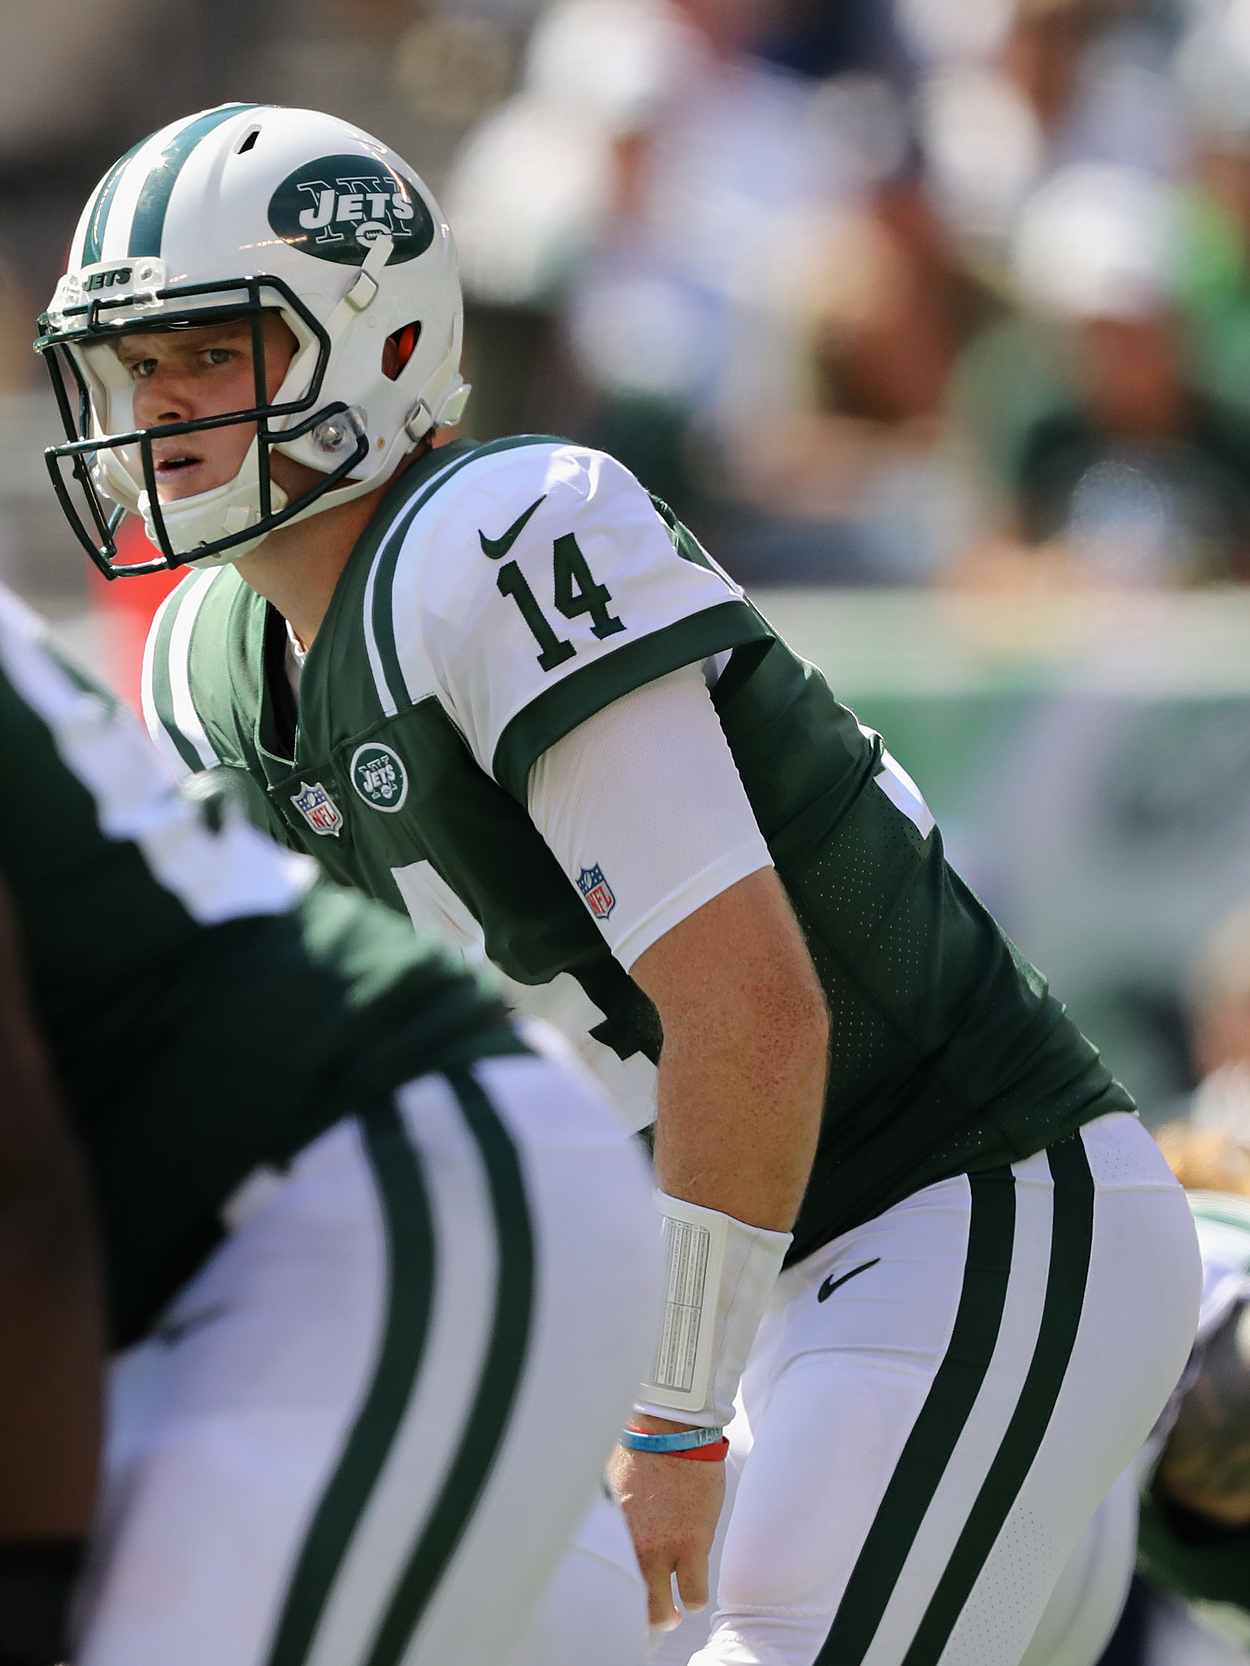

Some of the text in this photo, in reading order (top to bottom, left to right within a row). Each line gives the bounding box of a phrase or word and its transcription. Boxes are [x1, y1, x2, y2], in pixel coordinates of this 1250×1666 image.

[299, 189, 414, 229] JETS
[82, 267, 132, 291] JETS
[496, 532, 627, 672] 14
[363, 764, 396, 793] JETS
[309, 805, 337, 828] NFL
[586, 885, 613, 914] NFL
